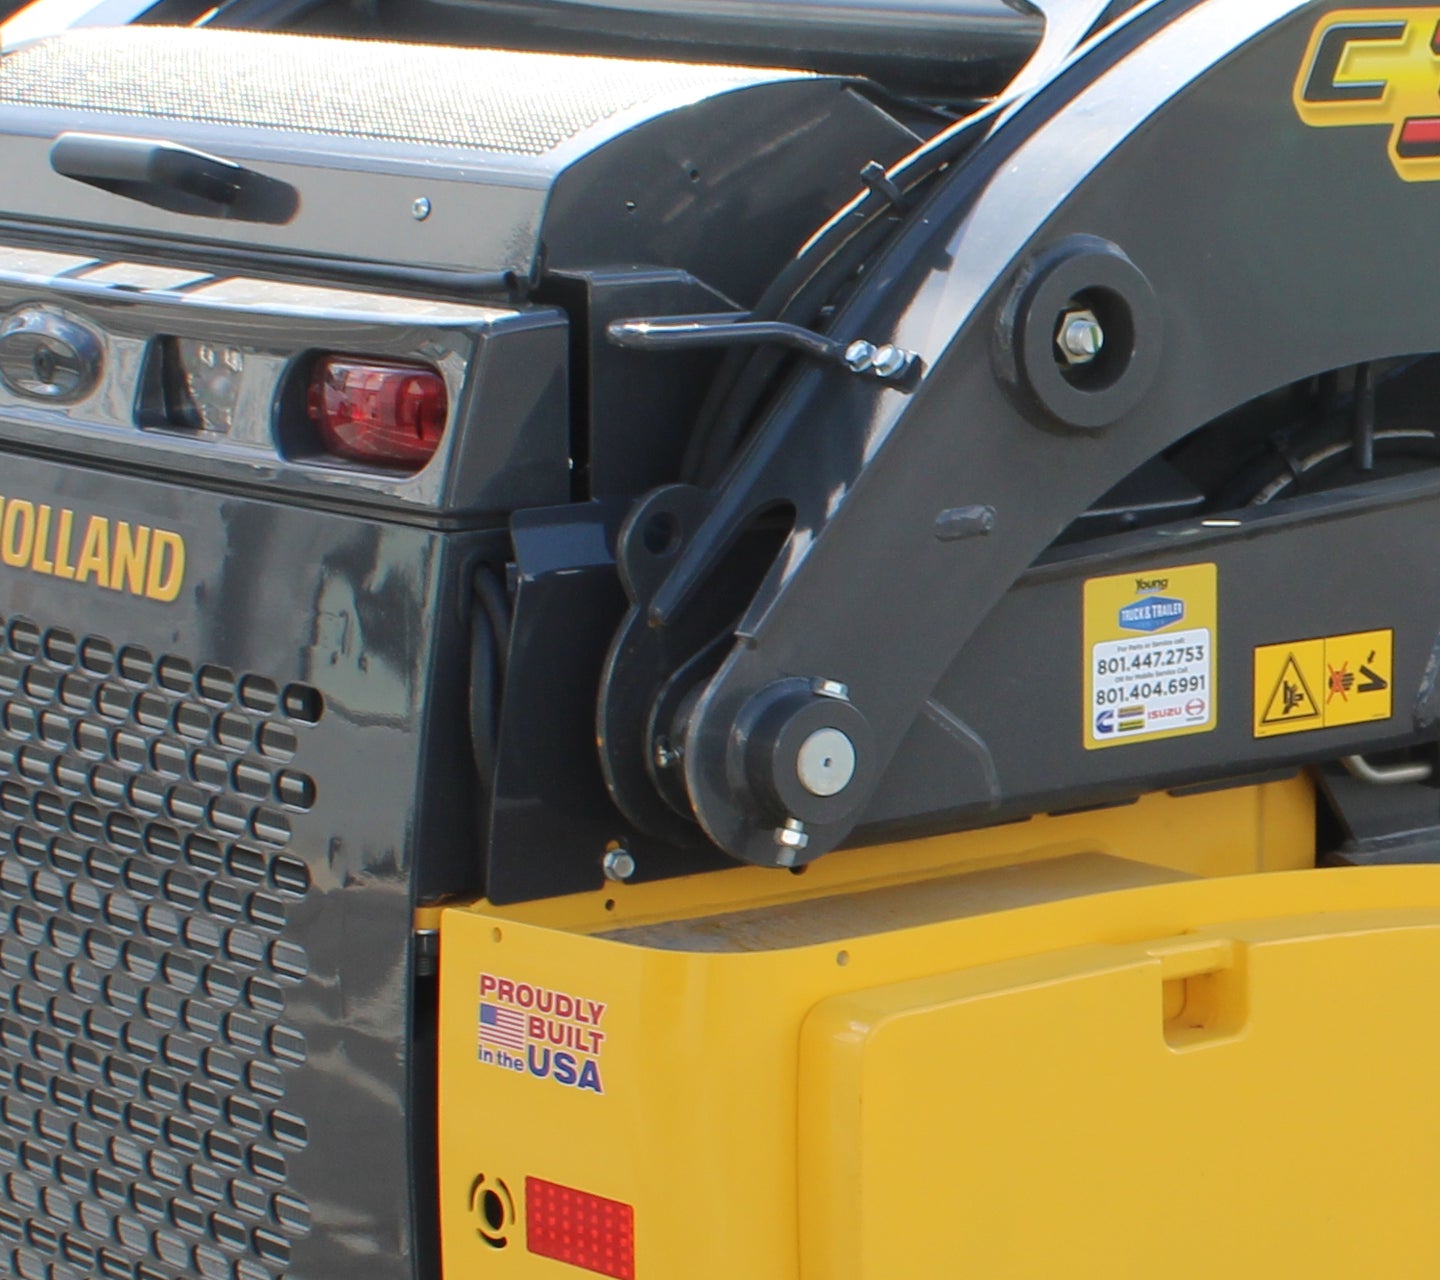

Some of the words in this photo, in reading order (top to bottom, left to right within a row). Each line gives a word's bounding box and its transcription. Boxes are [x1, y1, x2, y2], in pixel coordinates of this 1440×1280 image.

[1135, 578, 1169, 591] Young
[1121, 607, 1144, 621] TRUCK
[1152, 602, 1182, 618] TRAILER
[1097, 645, 1204, 675] 801.447.2753
[1096, 675, 1205, 705] 801.404.6991
[1147, 707, 1182, 720] ISUZU
[480, 974, 605, 1025] PROUDLY
[528, 1015, 604, 1054] BUILT
[478, 1044, 493, 1063] in
[497, 1051, 524, 1071] the
[527, 1044, 603, 1093] USA
